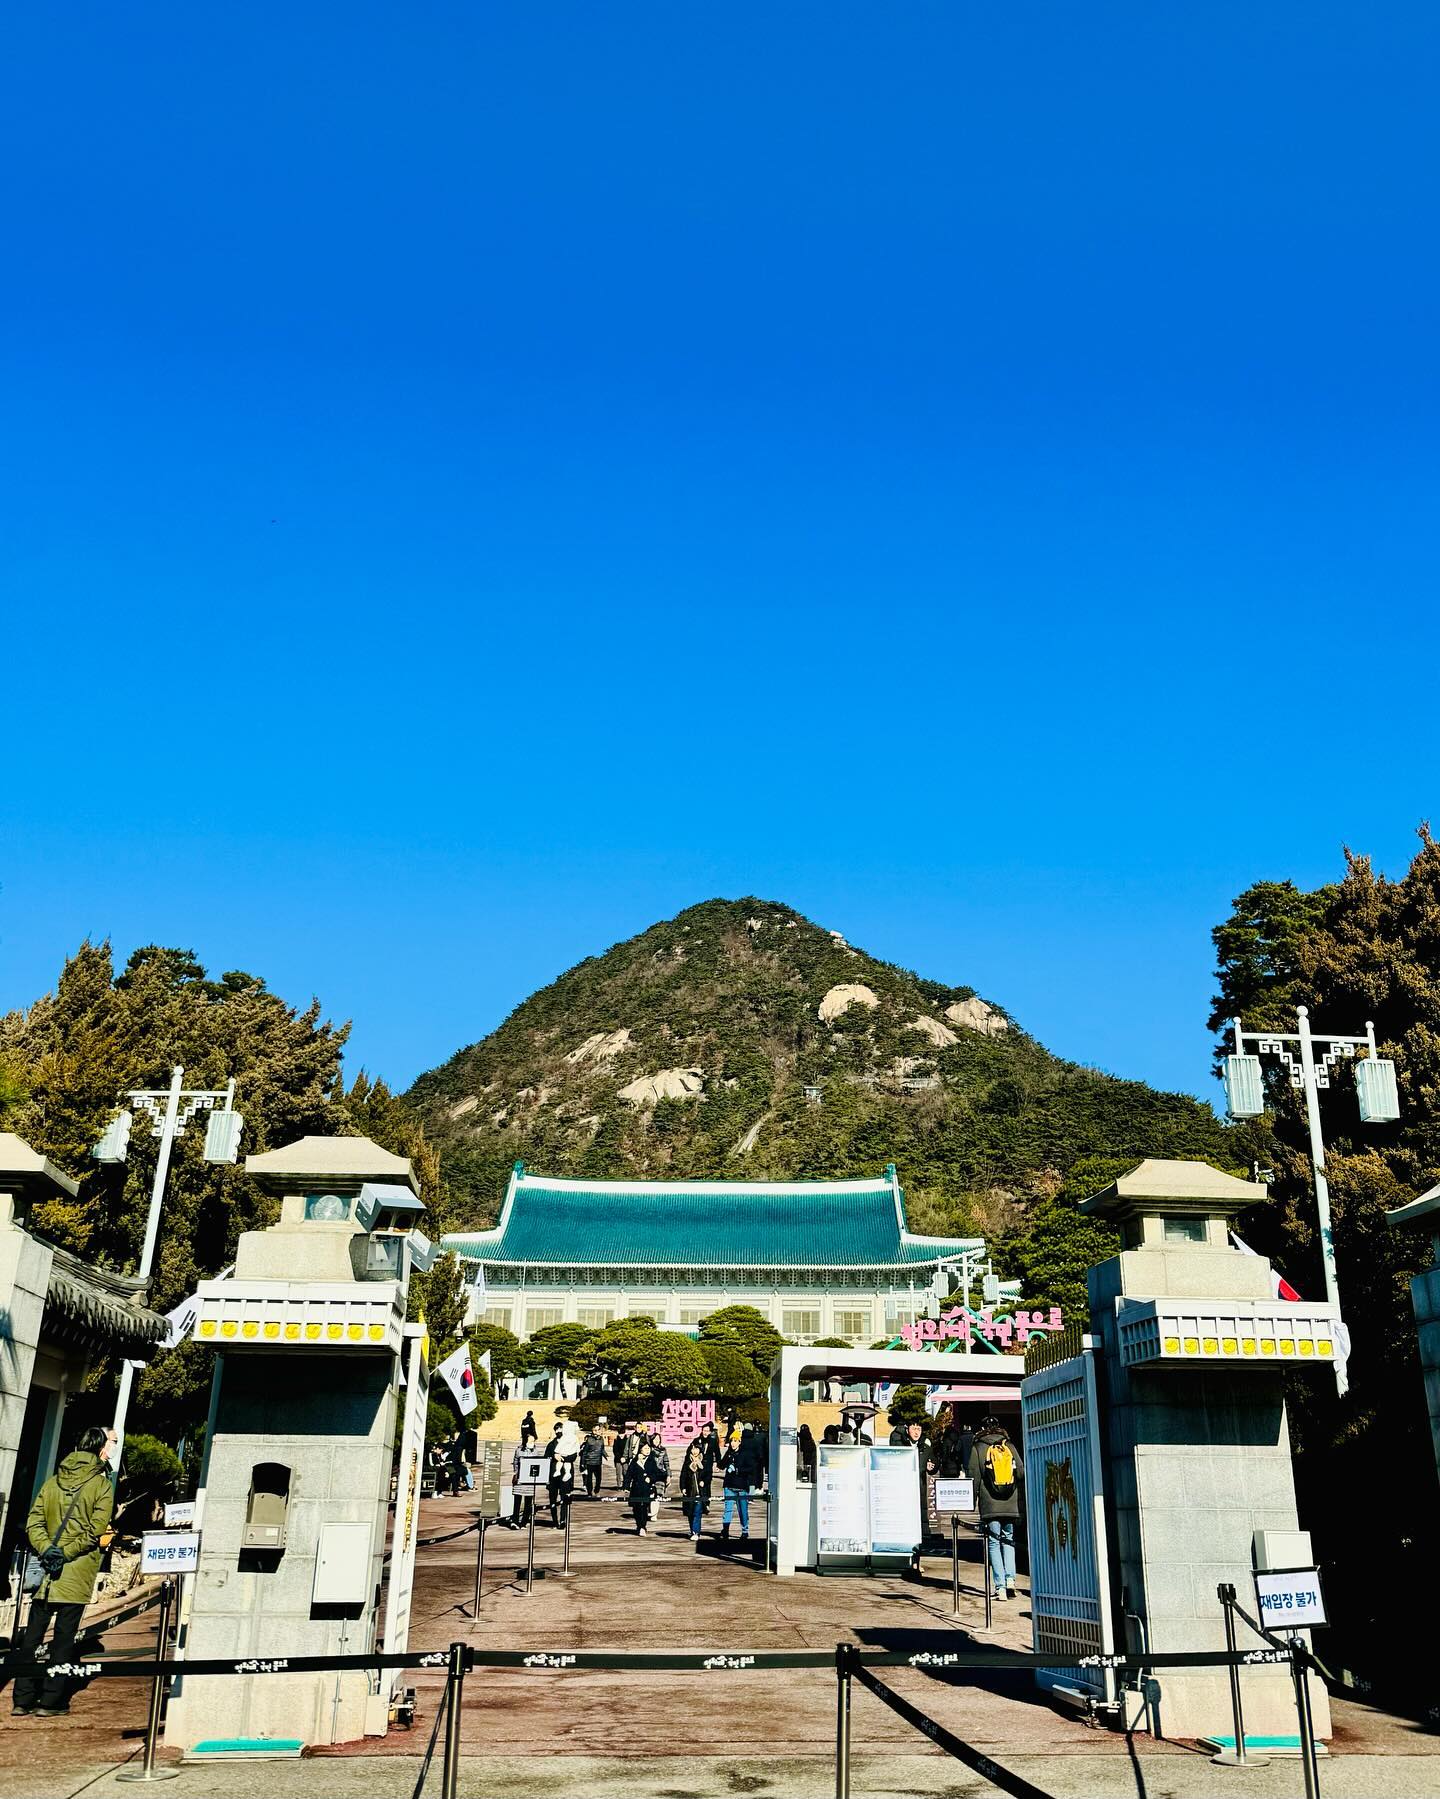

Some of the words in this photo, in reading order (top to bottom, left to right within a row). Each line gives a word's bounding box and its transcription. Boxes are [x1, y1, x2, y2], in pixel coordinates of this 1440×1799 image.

[977, 1312, 1012, 1346] 국민
[1014, 1307, 1064, 1341] 품으로
[661, 1398, 716, 1423] 청와대
[147, 1548, 176, 1560] 재입장
[178, 1546, 197, 1559] 불가
[1260, 1592, 1293, 1610] 재입장
[1295, 1591, 1317, 1608] 불가
